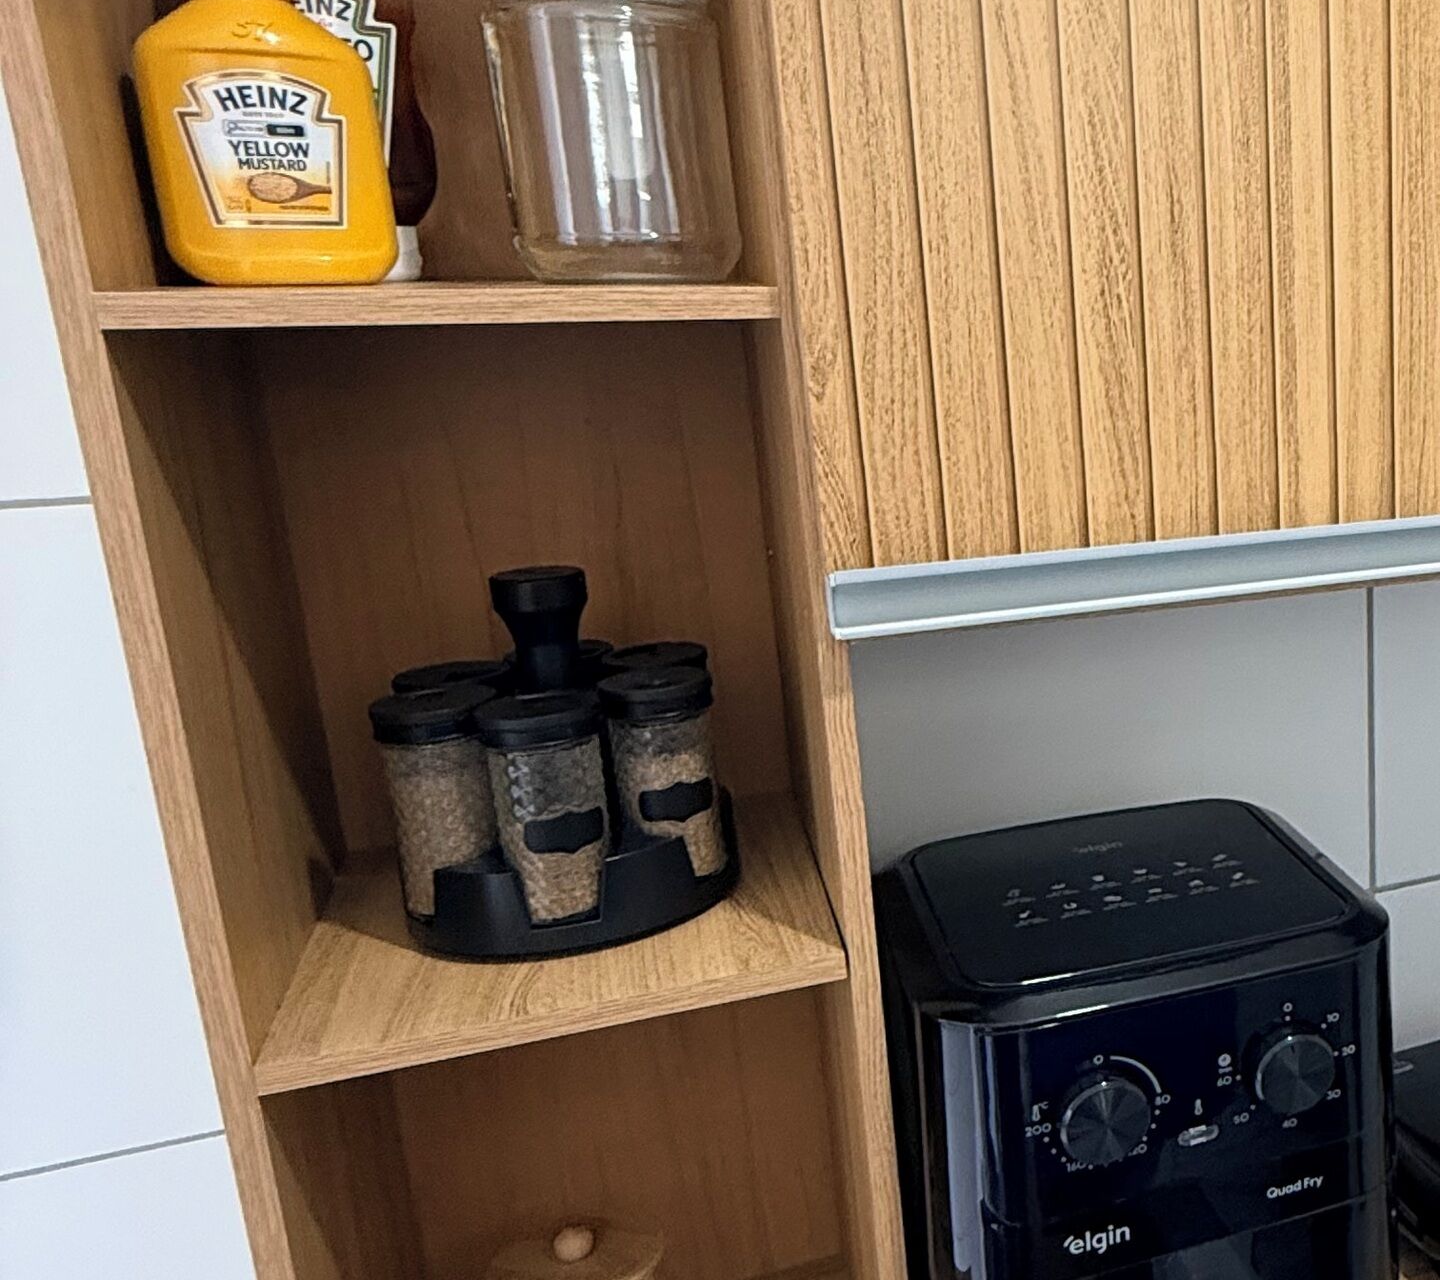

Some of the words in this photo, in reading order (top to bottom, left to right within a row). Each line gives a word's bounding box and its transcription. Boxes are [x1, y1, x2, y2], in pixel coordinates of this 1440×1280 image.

[213, 85, 308, 115] HEINZ
[228, 140, 309, 158] YELLOW
[238, 158, 307, 171] MUSTARD
[1283, 1002, 1293, 1012] 0
[1093, 1054, 1104, 1065] 0
[1266, 1178, 1302, 1199] Quad
[1303, 1175, 1324, 1191] Fry
[1064, 1224, 1131, 1255] elgin
